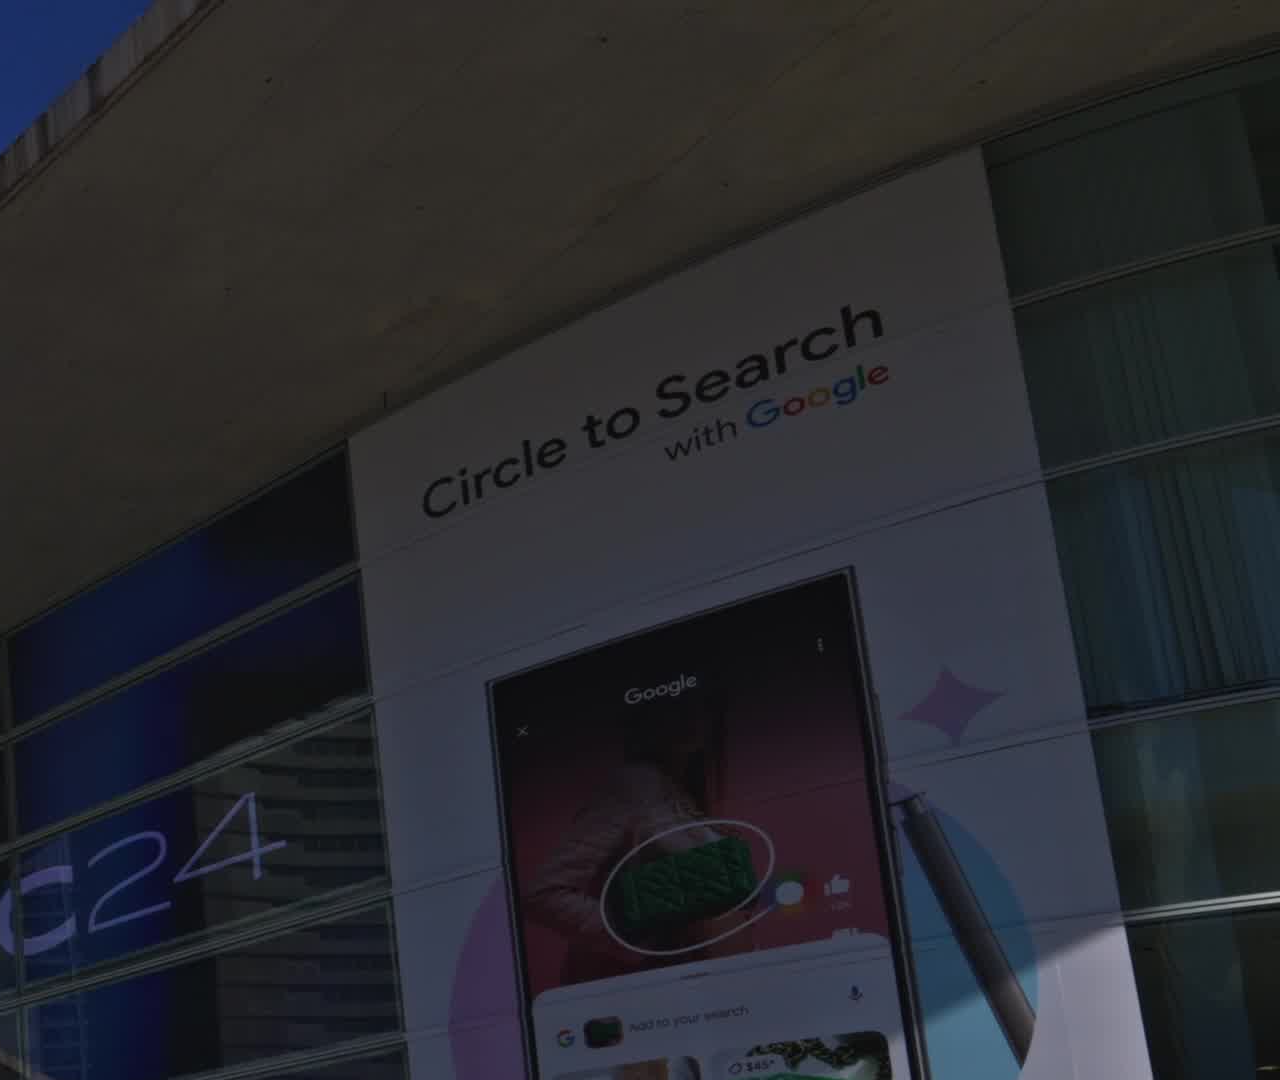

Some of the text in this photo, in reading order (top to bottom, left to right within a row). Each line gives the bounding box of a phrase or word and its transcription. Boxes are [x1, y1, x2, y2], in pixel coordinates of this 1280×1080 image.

[422, 303, 885, 519] Circle to Search
[664, 362, 890, 462] with Google
[623, 672, 697, 705] Google
